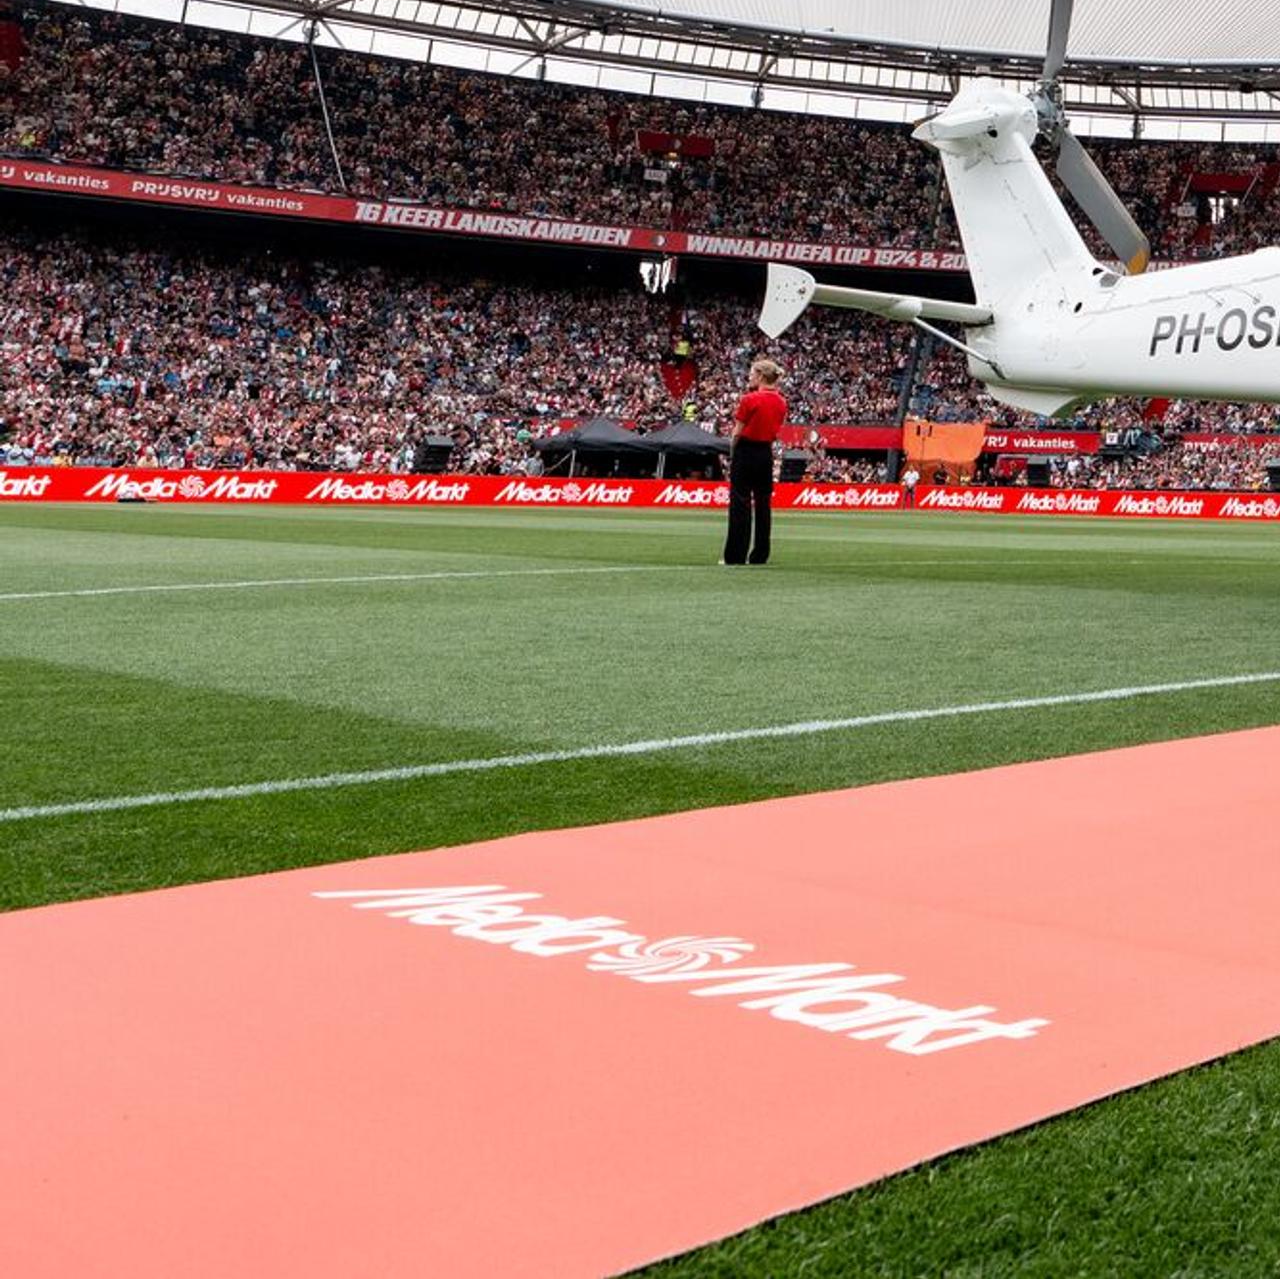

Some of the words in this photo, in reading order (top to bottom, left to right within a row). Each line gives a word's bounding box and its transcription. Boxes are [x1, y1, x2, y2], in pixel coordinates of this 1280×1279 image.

[23, 168, 110, 190] vakanties
[227, 192, 305, 211] vakanties
[354, 202, 381, 221] 16
[381, 204, 444, 228] KEER
[686, 234, 784, 259] WINNAAR
[784, 243, 833, 263] UEFA
[834, 247, 871, 265] CUP
[1013, 435, 1076, 450] vakanties
[84, 473, 178, 498] Media
[200, 475, 278, 498] Markt
[304, 478, 387, 500] Media
[405, 478, 470, 501] Markt
[494, 481, 563, 502] Media
[577, 483, 634, 503] Markt
[653, 484, 712, 505] Media
[792, 487, 845, 506] Media
[855, 488, 900, 506] Markt
[919, 490, 965, 508] Media
[967, 490, 1004, 508] Markt
[1016, 492, 1057, 510] Media
[1061, 493, 1100, 511] Markt
[1113, 495, 1157, 514] Media
[1163, 495, 1204, 515] Markt
[1218, 497, 1264, 517] Media
[311, 885, 647, 957] Media
[630, 963, 1052, 1056] Markt
